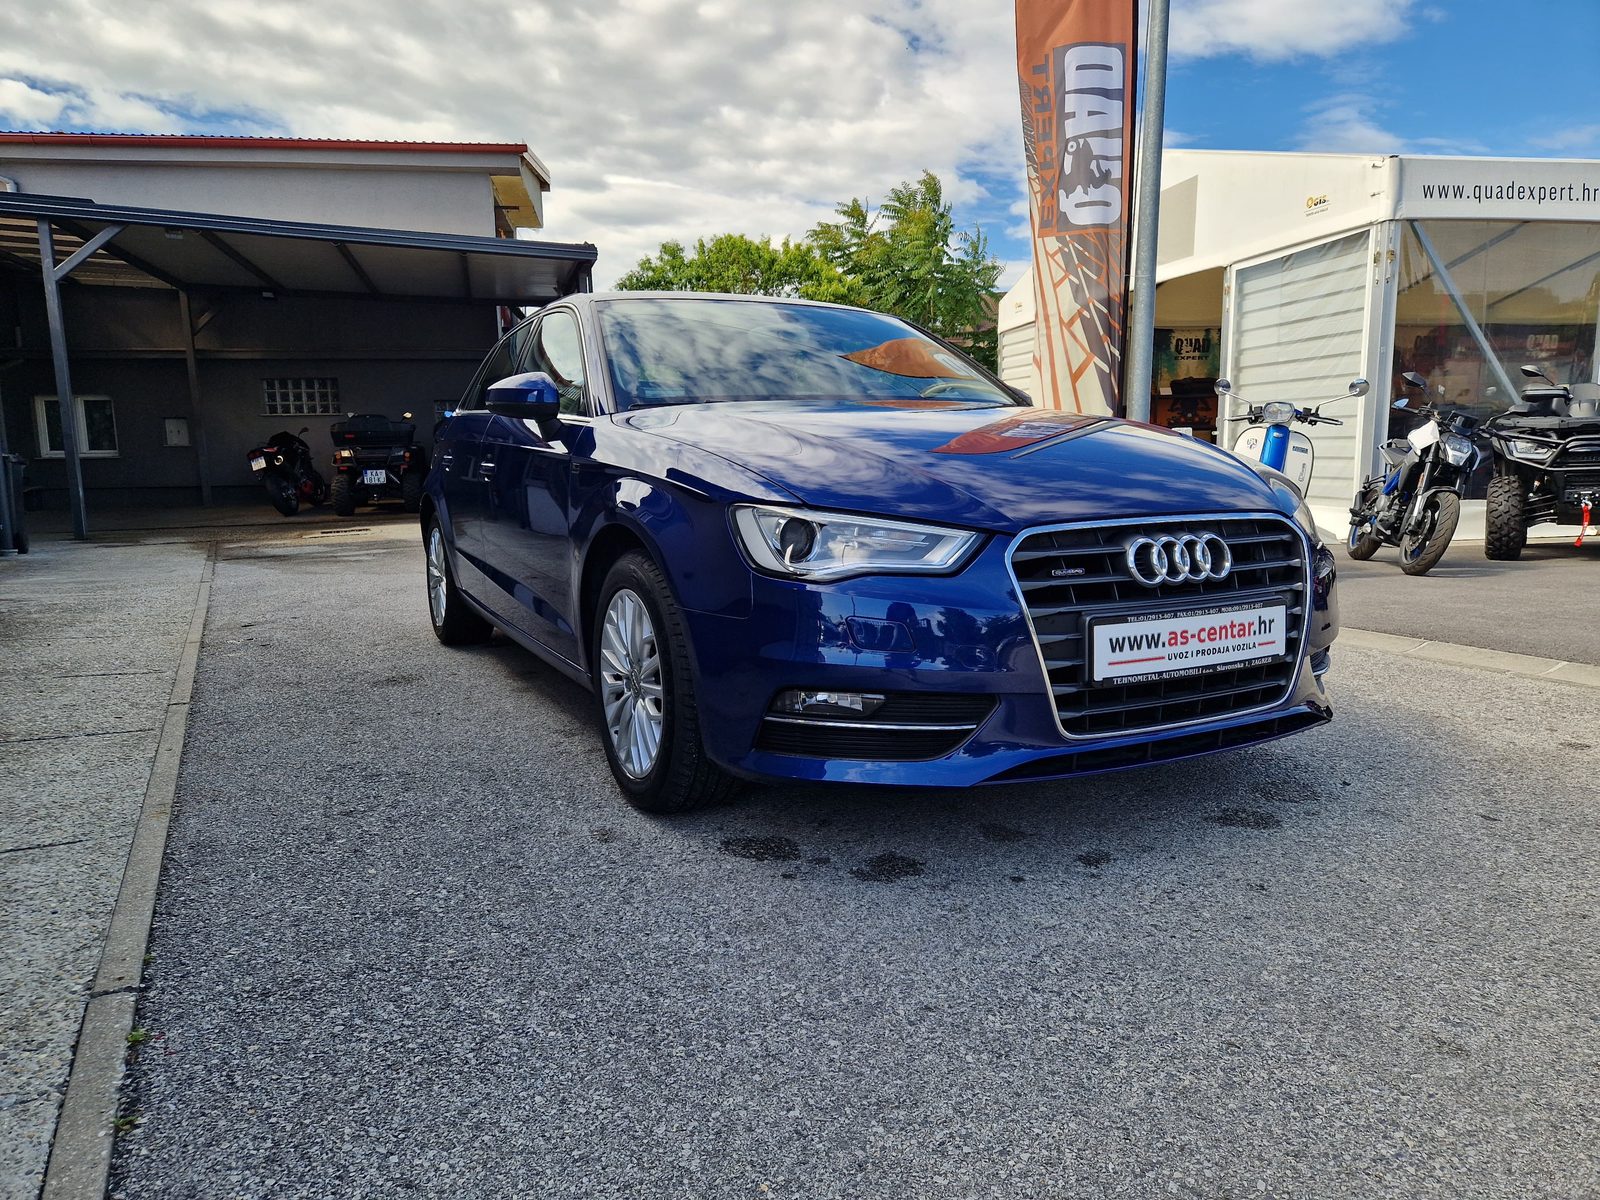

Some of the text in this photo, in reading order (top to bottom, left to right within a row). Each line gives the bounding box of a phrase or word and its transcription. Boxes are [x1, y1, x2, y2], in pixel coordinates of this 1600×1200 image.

[1422, 180, 1600, 204] www.quadexpert.hr
[1175, 337, 1210, 354] QUAD
[1109, 615, 1275, 653] www.as-centar.hr
[1167, 651, 1189, 661] UVOZ
[1196, 647, 1230, 658] PRODAJA
[1231, 642, 1257, 652] VOZILA
